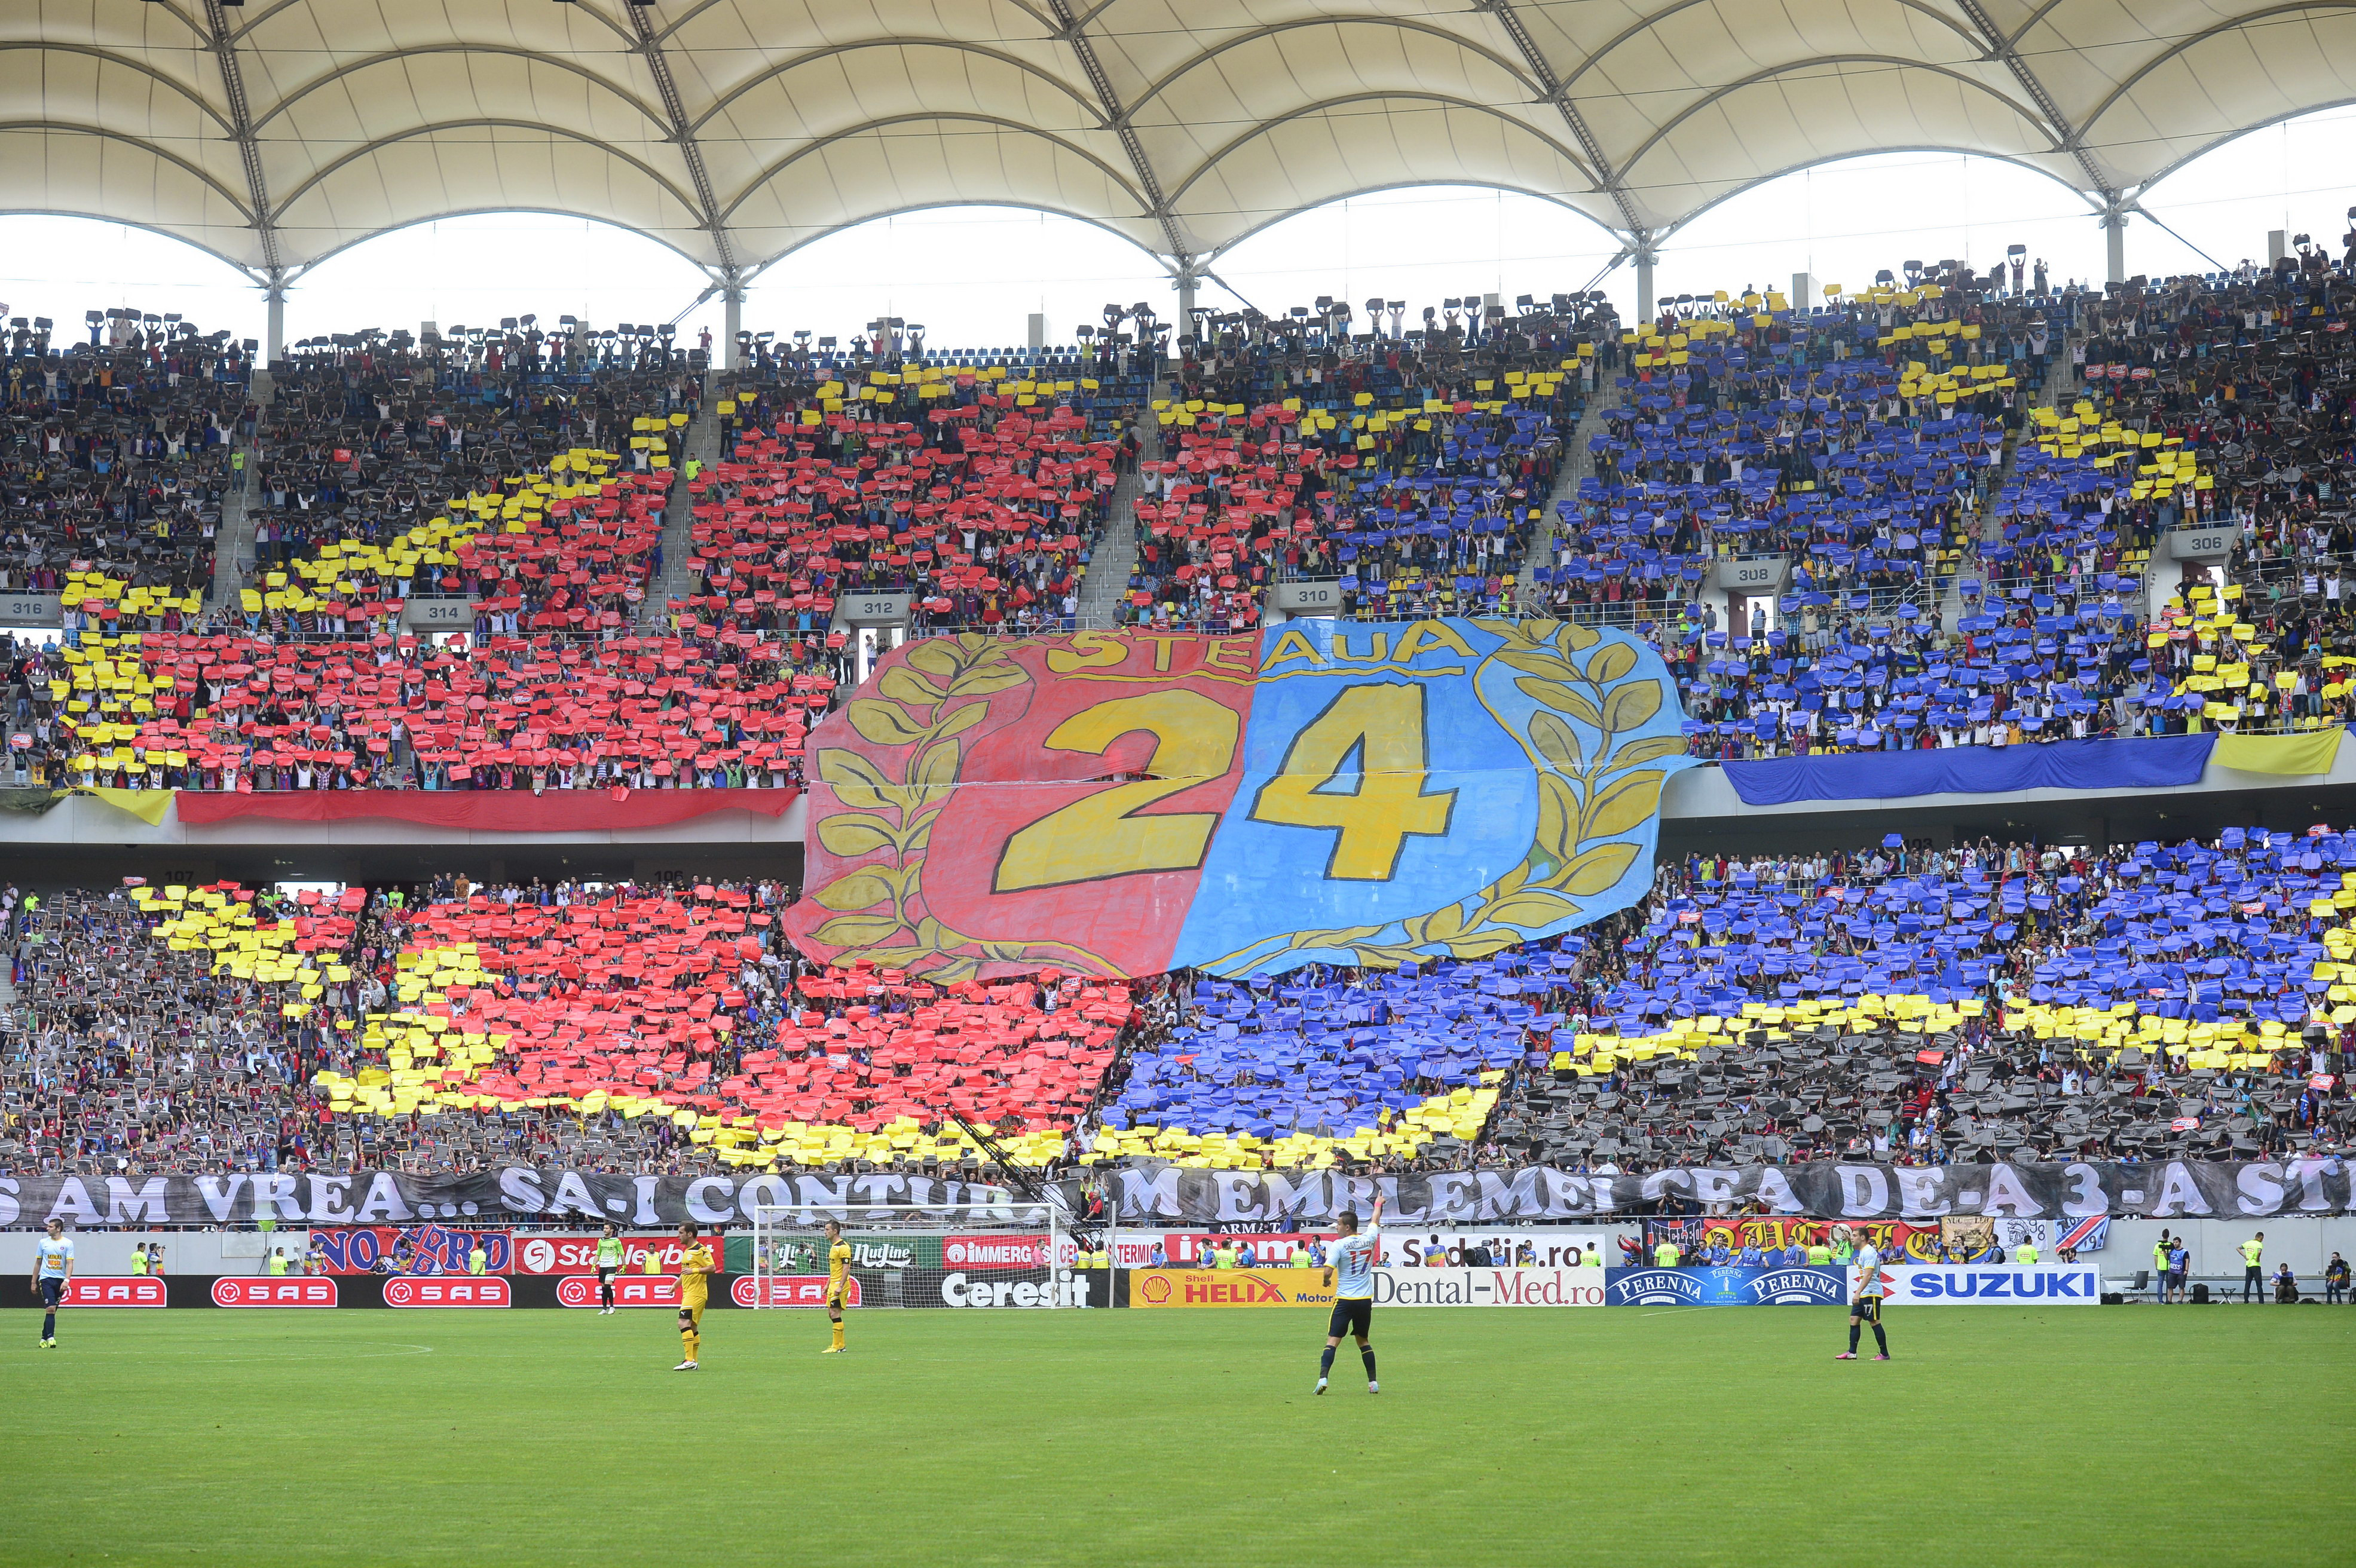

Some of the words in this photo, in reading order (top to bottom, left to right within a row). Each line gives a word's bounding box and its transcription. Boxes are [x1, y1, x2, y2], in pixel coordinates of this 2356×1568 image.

[2192, 537, 2222, 550] 306
[1739, 569, 1768, 581] 308
[1299, 590, 1328, 602] 310
[13, 603, 42, 614] 316
[429, 607, 458, 618] 314
[864, 602, 893, 613] 312
[1047, 620, 1481, 673] STEAUA
[990, 681, 1459, 895] 24
[164, 871, 195, 882] 107
[957, 1119, 972, 1134] MOVIS
[984, 1144, 999, 1160] MOVIS
[44, 1176, 170, 1224] AM
[193, 1171, 478, 1223] VREA...
[500, 1167, 660, 1225] SA-I
[1212, 1166, 1614, 1223] EMBLEMEI
[1642, 1166, 1804, 1212] CEA
[1834, 1163, 2044, 1218] DE-A
[2062, 1158, 2213, 1218] 3-A
[2236, 1159, 2356, 1216] ST
[852, 1243, 911, 1267] NutLine
[968, 1242, 1051, 1263] iMMERGS
[1350, 1250, 1372, 1275] 17
[1712, 1269, 1742, 1278] PERENNA
[942, 1270, 1090, 1307] Ceresit
[1373, 1270, 1604, 1304] Dental-Med.ro
[1616, 1276, 1702, 1300] PERENNA
[1751, 1275, 1837, 1300] PERENNA
[1911, 1272, 2095, 1298] SUZUKI
[80, 1286, 157, 1300] SAS
[249, 1286, 327, 1300] SAS
[421, 1286, 501, 1300] SAS
[1185, 1284, 1283, 1303] HELIX
[1296, 1293, 1333, 1303] Motor
[1864, 1304, 1873, 1316] 17
